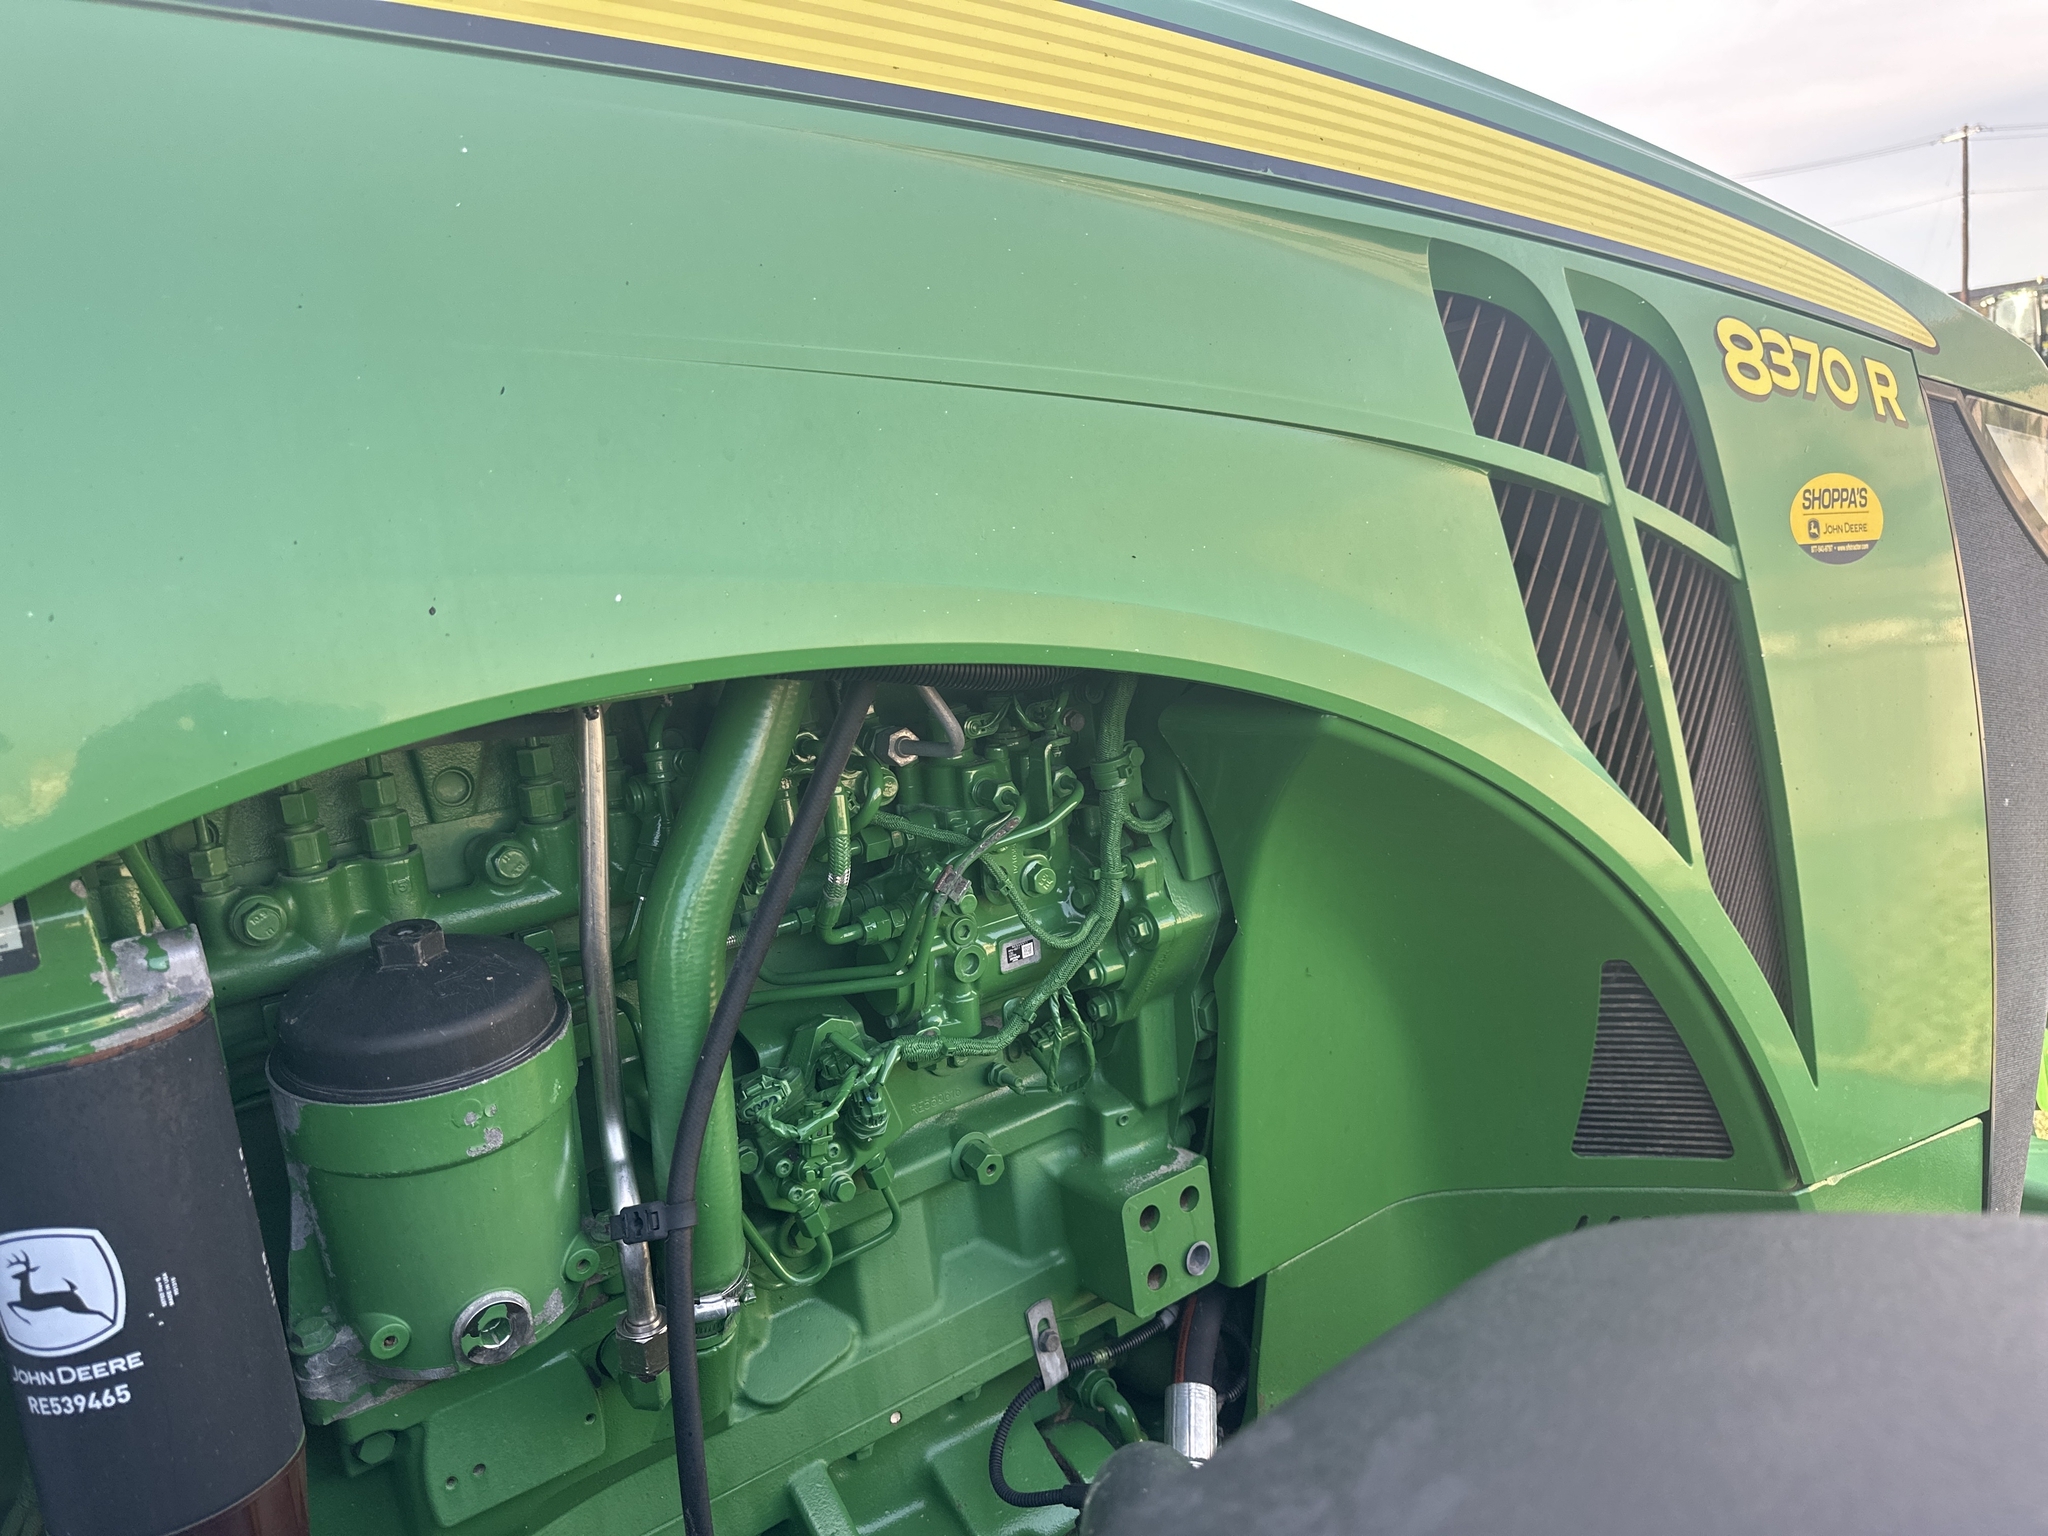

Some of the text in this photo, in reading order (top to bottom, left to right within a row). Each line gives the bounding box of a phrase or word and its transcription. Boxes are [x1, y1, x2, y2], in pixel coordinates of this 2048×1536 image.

[1714, 315, 1908, 427] 8370 R
[1802, 487, 1868, 510] SHOPPA'S
[1823, 522, 1868, 535] JOHN DEERE
[13, 1351, 145, 1386] JOHN DEERE
[27, 1384, 132, 1416] RE539465
